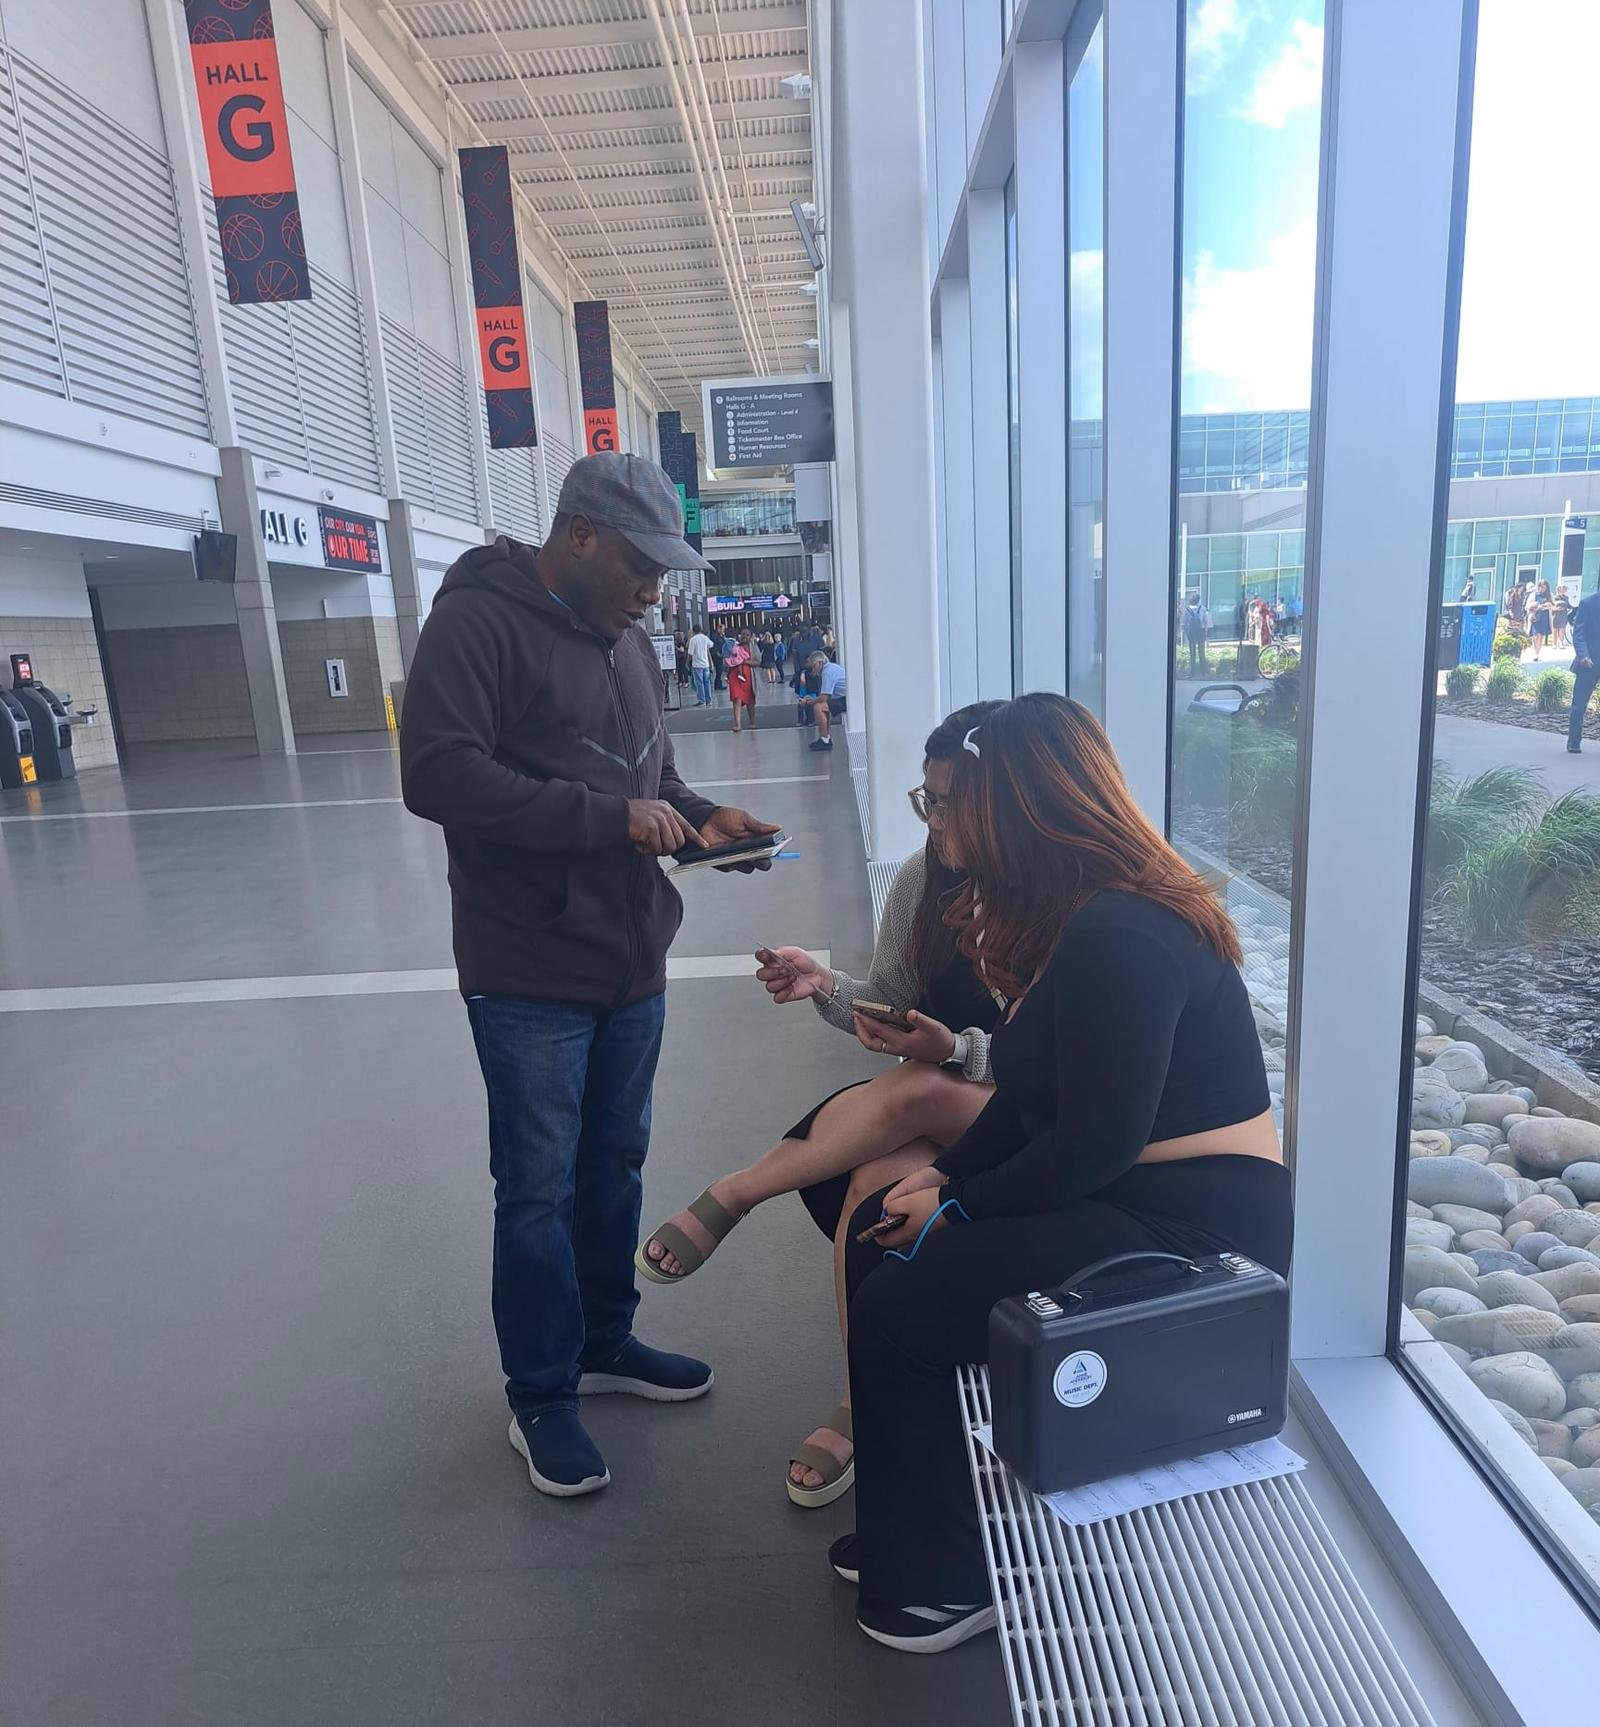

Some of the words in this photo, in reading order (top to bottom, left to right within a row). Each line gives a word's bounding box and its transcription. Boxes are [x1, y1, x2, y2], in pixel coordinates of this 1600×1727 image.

[206, 62, 268, 85] HALL
[218, 94, 275, 162] G
[484, 319, 518, 332] HALL
[489, 336, 520, 373] G
[736, 410, 777, 418] Administration
[588, 416, 612, 426] HALL
[592, 429, 614, 452] G
[738, 435, 773, 443] Ticketmaster
[261, 509, 295, 546] ALL
[294, 516, 309, 546] G
[1580, 519, 1585, 527] 5
[328, 535, 348, 559] OUR
[348, 538, 369, 562] TIME
[717, 602, 745, 610] BUILD
[1063, 1386, 1083, 1395] MUSIC
[1236, 1408, 1262, 1421] YAMAHA
